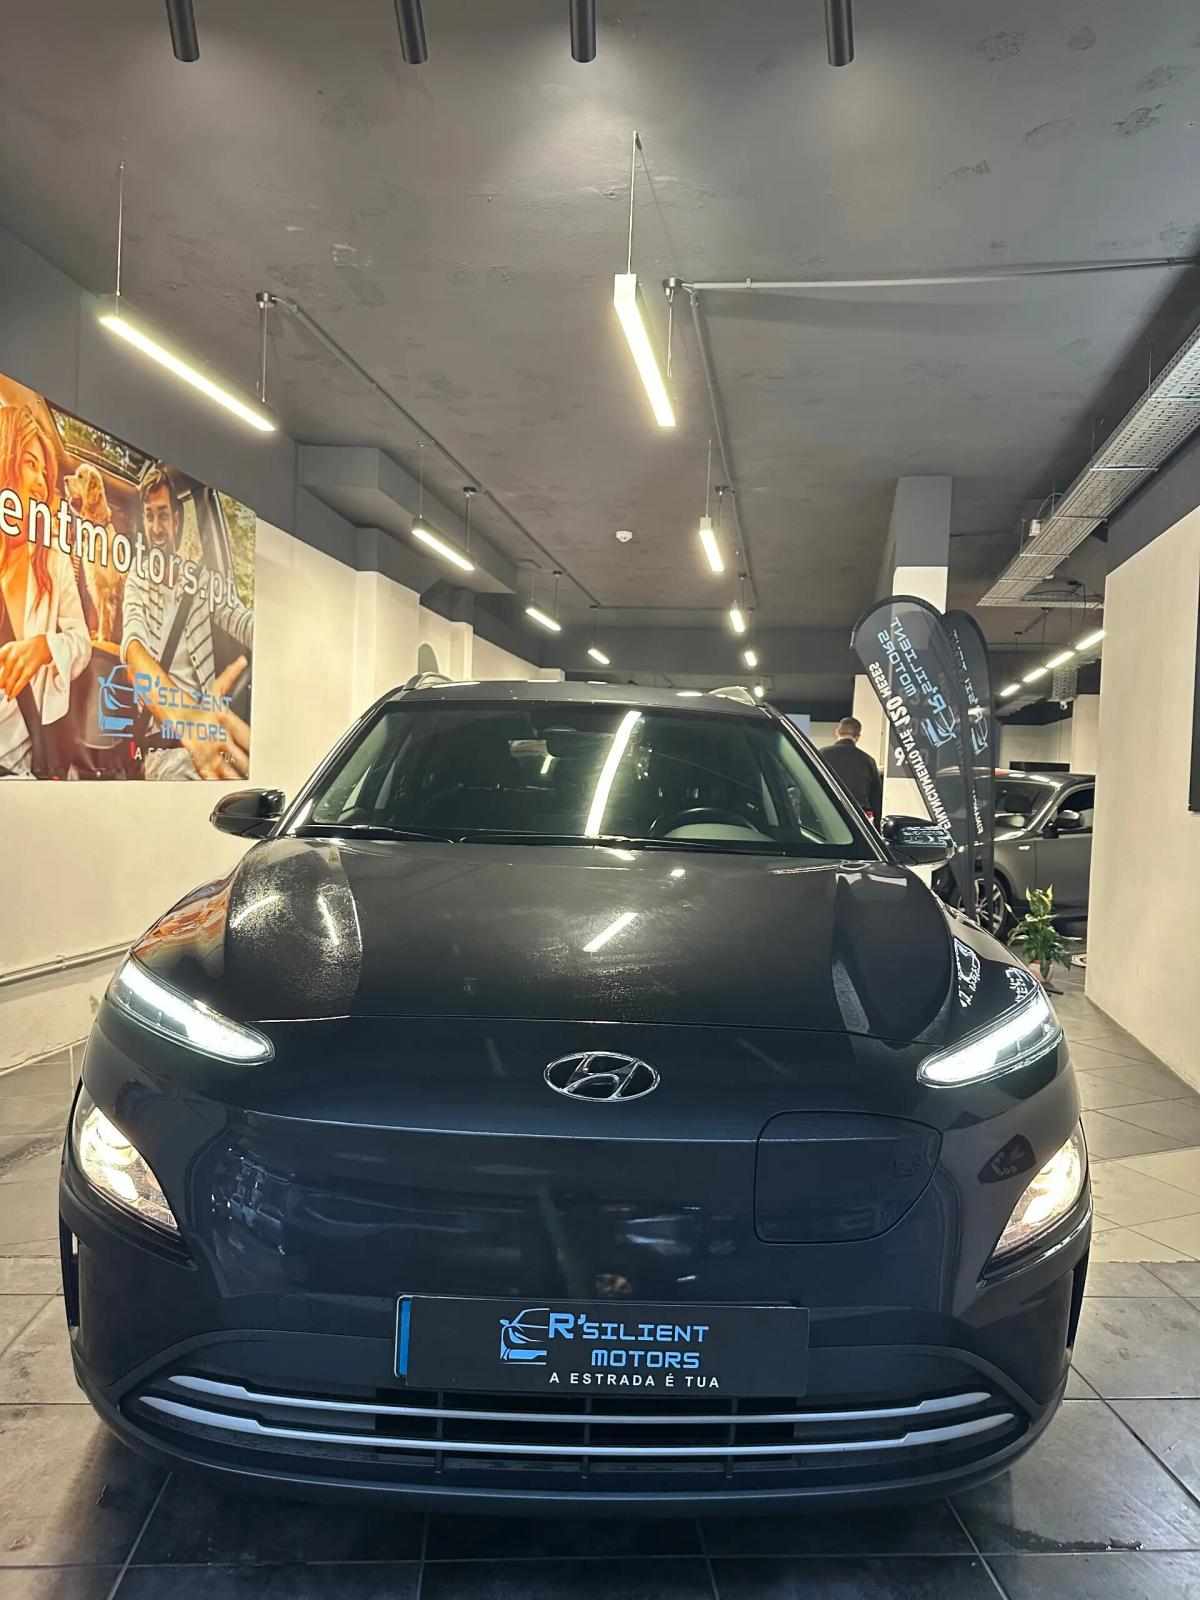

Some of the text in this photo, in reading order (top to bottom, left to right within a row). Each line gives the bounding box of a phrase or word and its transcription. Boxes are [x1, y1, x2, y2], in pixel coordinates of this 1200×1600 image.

[161, 719, 228, 742] MOTORS
[548, 1312, 710, 1343] R'SILIENT
[591, 1349, 700, 1369] MOTORS
[548, 1372, 720, 1389] A ESTRADA É TUA
